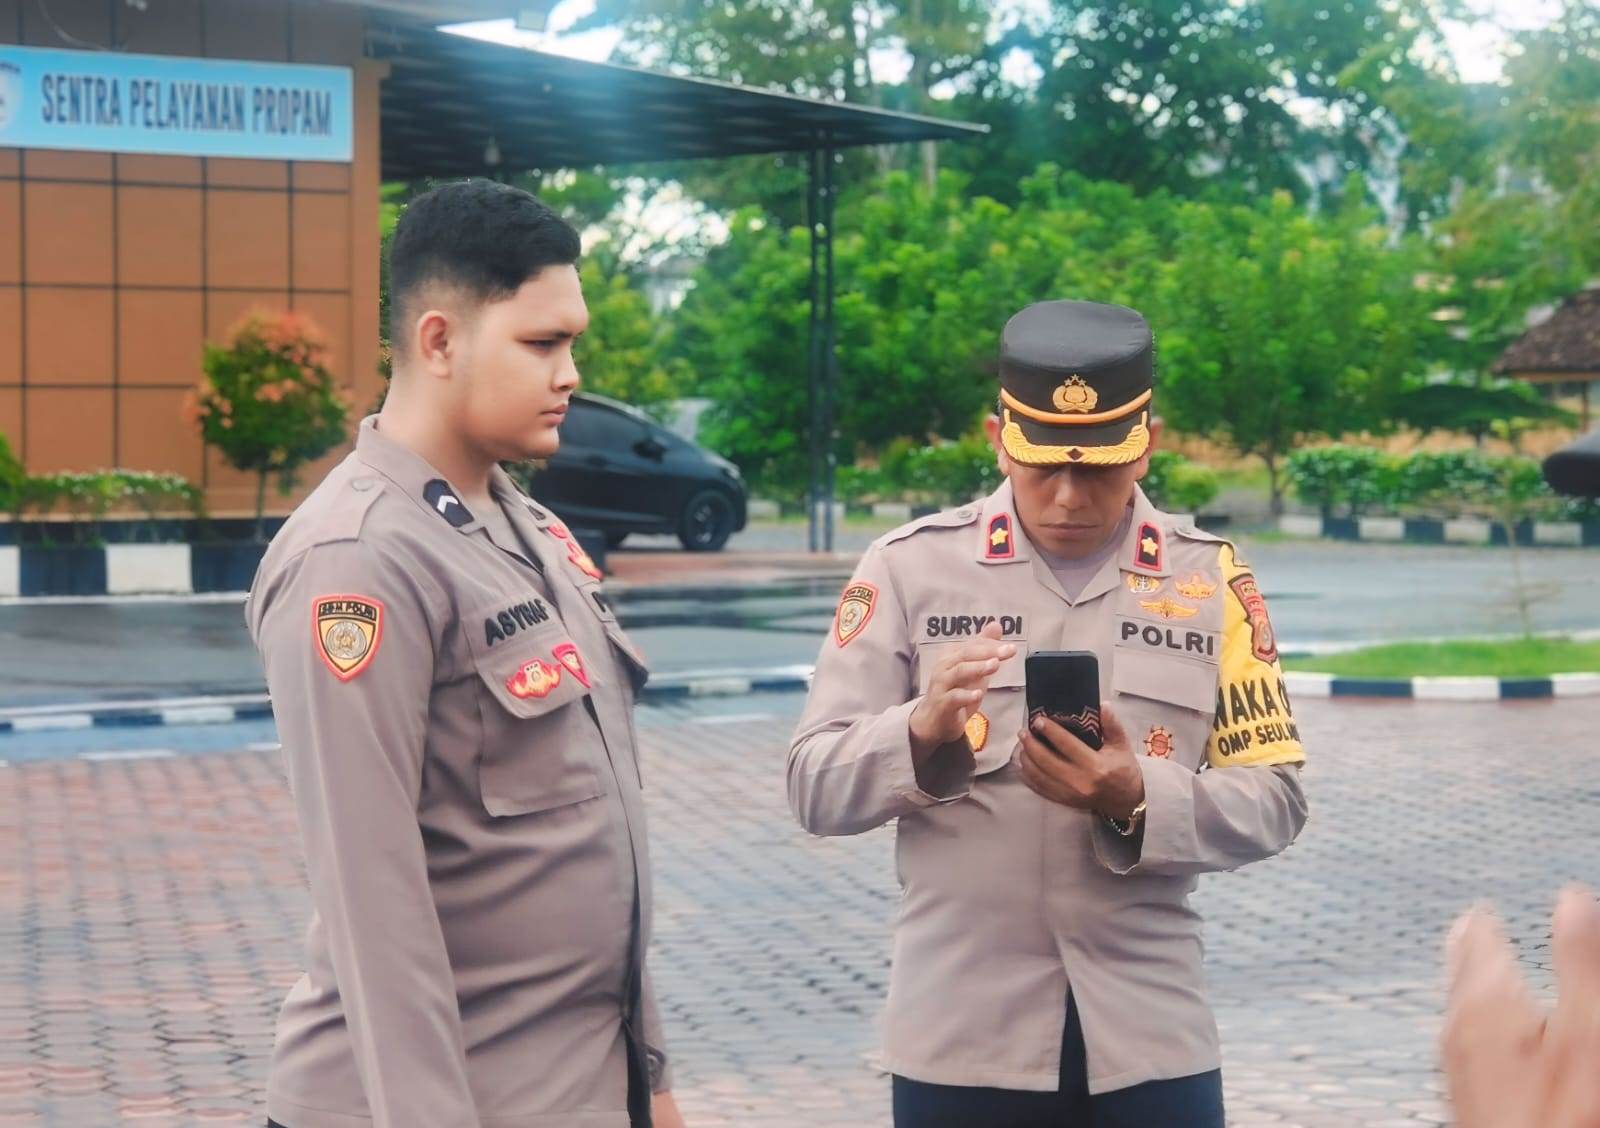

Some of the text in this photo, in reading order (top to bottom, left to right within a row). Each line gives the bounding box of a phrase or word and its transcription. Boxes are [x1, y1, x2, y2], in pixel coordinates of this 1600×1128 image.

[41, 73, 333, 137] SENTRA PELAYANAN PROPAM
[484, 598, 549, 647] ASYRAF
[1121, 621, 1214, 656] POLRI
[1217, 729, 1251, 757] OMP
